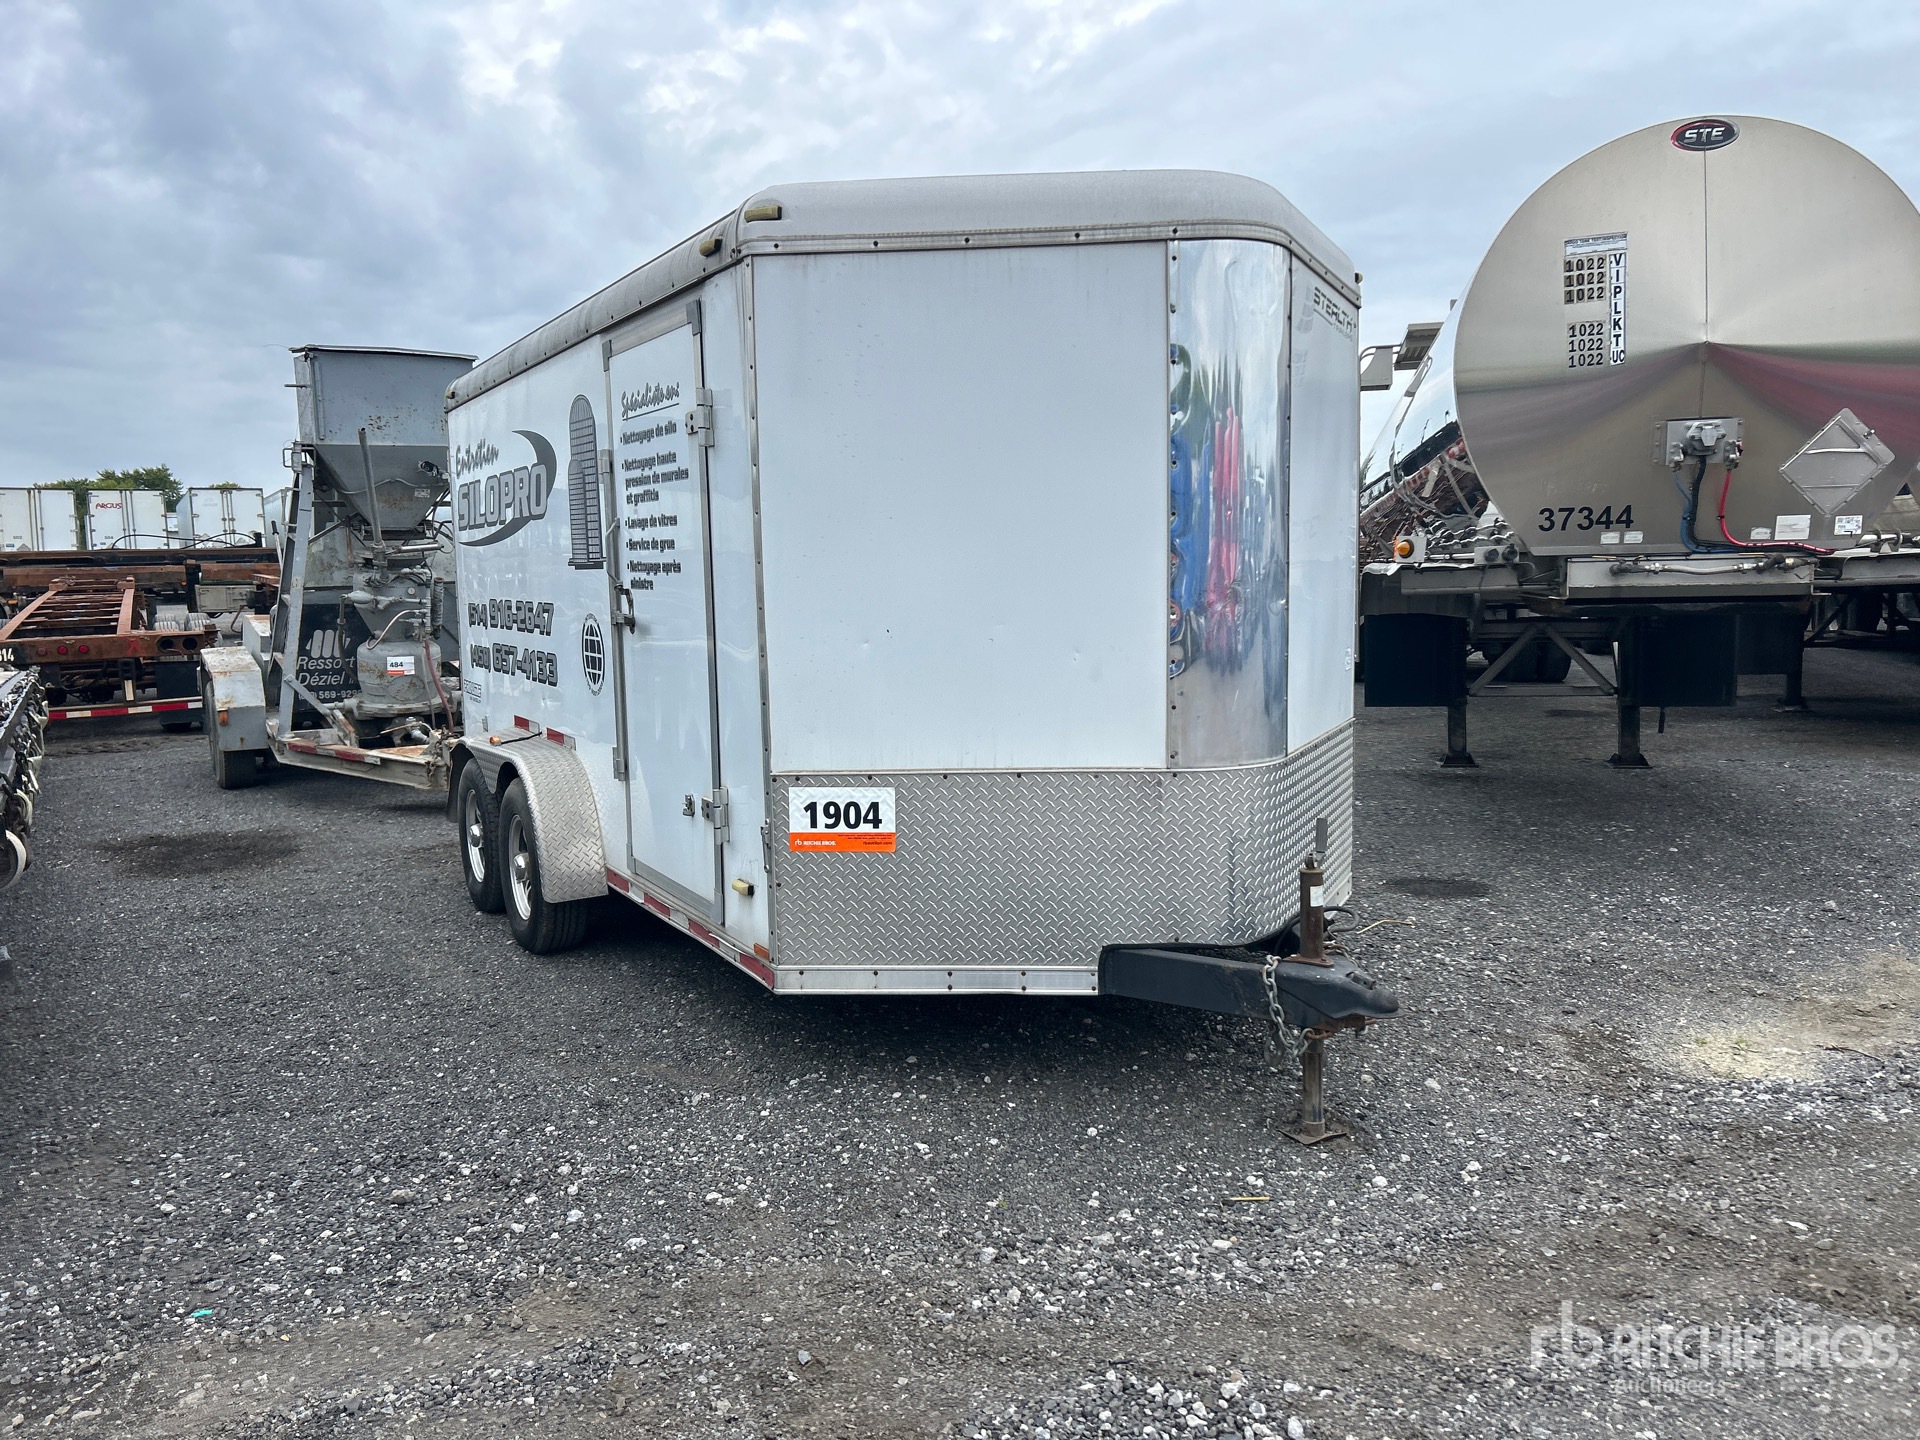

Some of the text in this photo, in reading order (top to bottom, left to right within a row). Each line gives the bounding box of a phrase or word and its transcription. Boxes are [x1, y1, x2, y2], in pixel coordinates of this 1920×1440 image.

[1683, 126, 1726, 143] STE
[1565, 257, 1605, 273] 1022
[1565, 271, 1605, 288] 1022
[1565, 286, 1605, 303] 1022
[1313, 286, 1353, 334] STEALTH
[1568, 322, 1604, 339] 1022
[1568, 337, 1603, 353] 1022
[1568, 352, 1604, 369] 1022
[623, 420, 677, 446] Nettoyage de silo
[455, 438, 499, 480] Entretien
[624, 450, 677, 472] Nettoyage haute
[625, 466, 689, 491] pression de murales
[95, 502, 123, 510] ARGUS
[458, 463, 548, 532] SILOPRO
[626, 492, 634, 505] et
[628, 513, 678, 531] Lavage de vitres
[1538, 504, 1634, 532] 37344
[628, 537, 676, 553] Service de grue
[629, 559, 681, 576] Nettoyage après
[630, 577, 654, 590] sinistre
[489, 598, 555, 637] 916-2647
[0, 647, 15, 661] 14
[492, 642, 558, 688] 657-4133
[298, 671, 346, 686] Déziel
[803, 800, 883, 830] 1904
